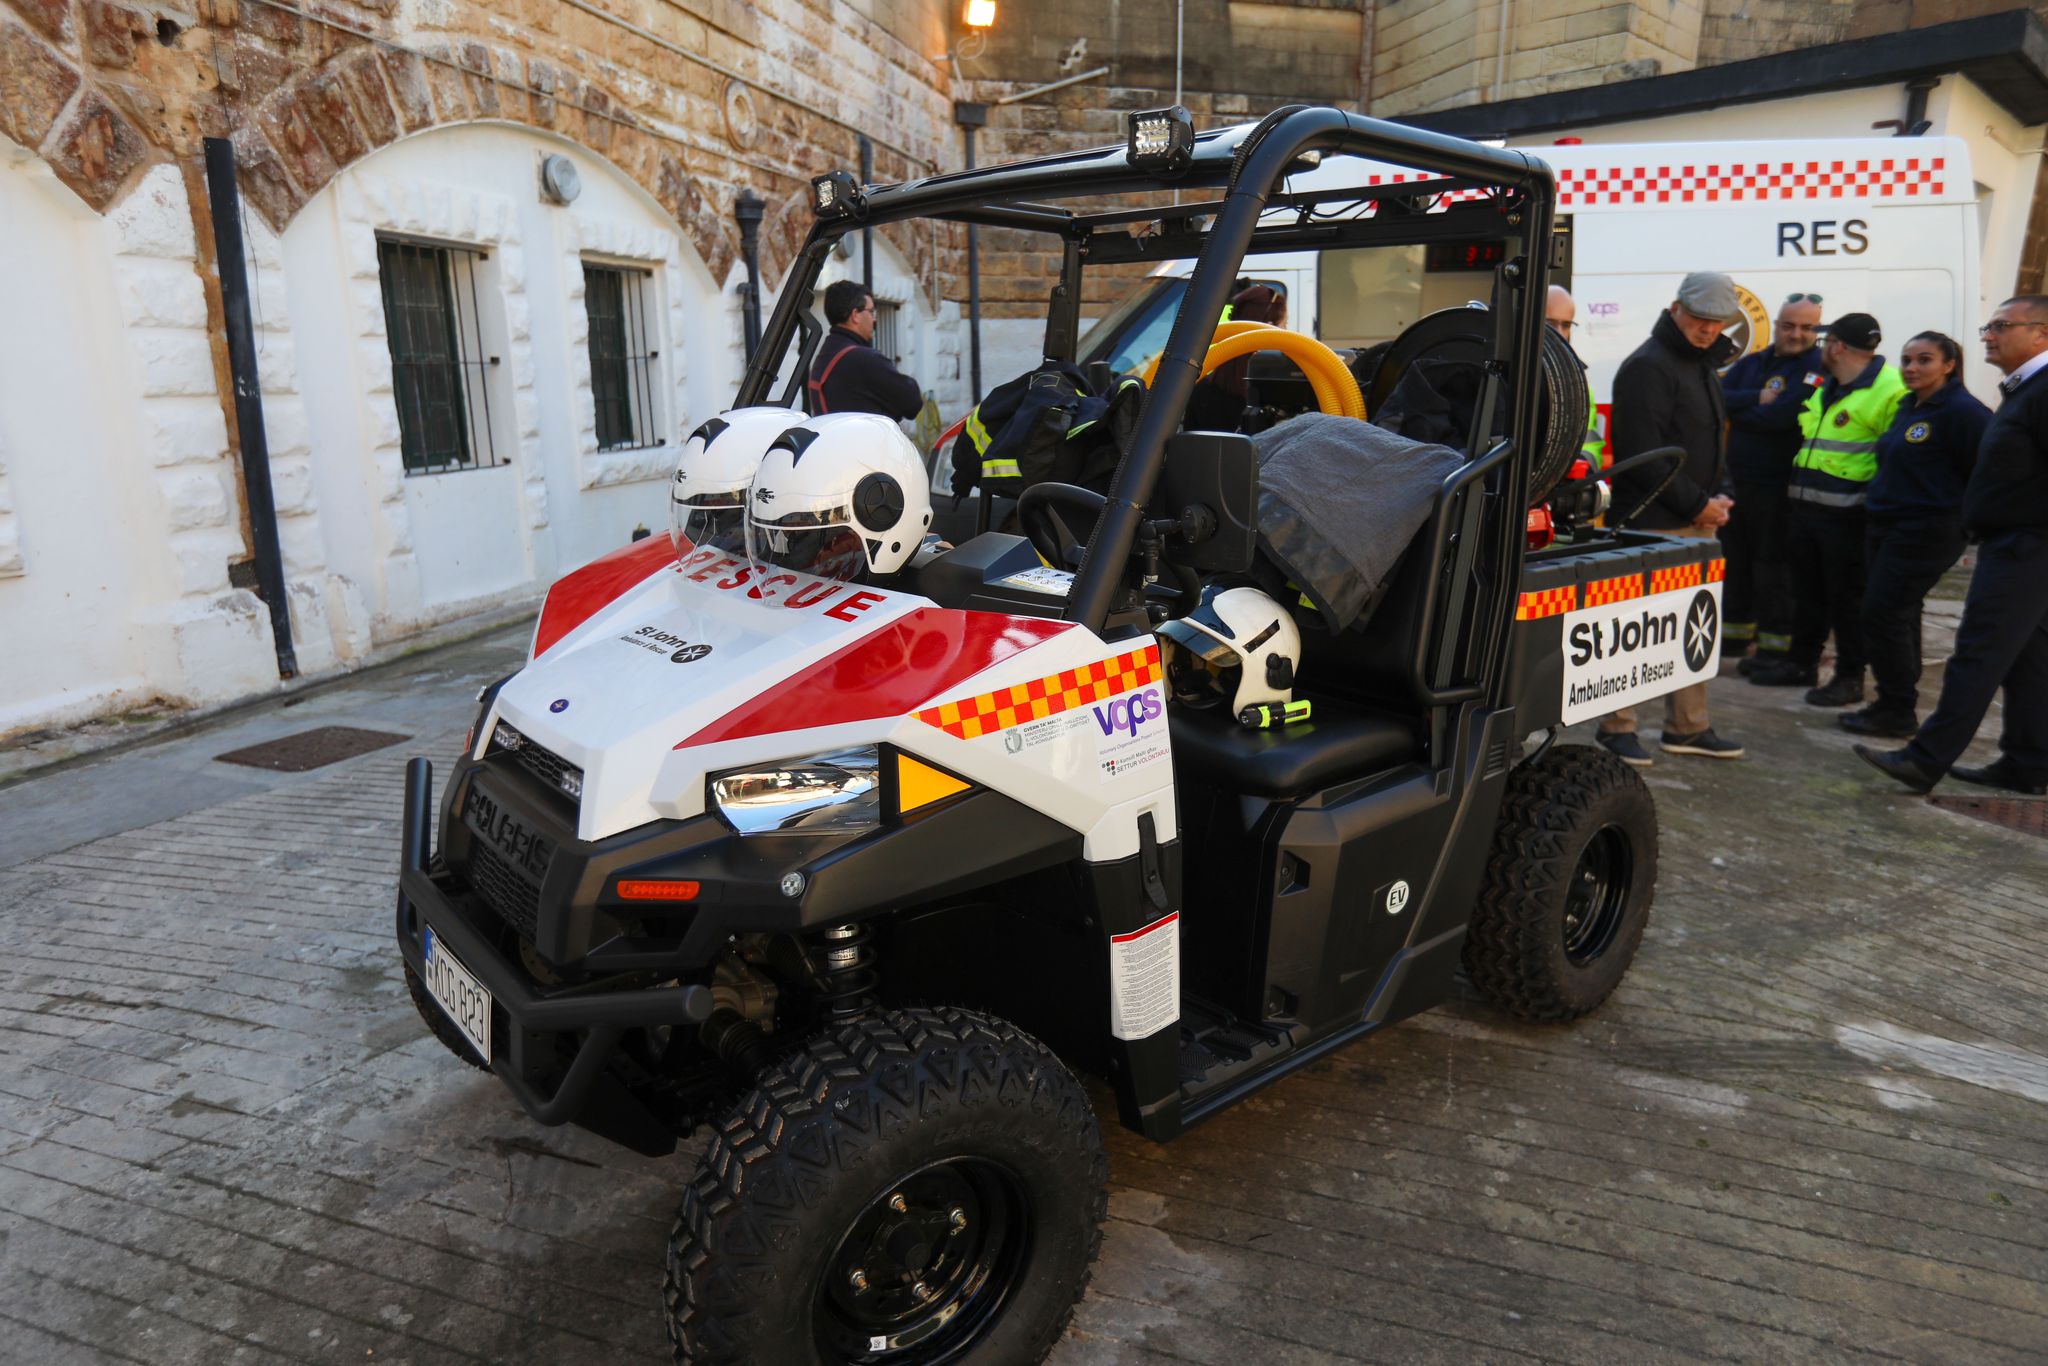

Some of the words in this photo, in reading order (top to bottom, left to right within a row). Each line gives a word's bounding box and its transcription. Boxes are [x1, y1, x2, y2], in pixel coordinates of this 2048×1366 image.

[1777, 219, 1869, 257] RES
[668, 550, 889, 623] RESCUE
[635, 626, 657, 637] St
[648, 631, 687, 649] John
[1569, 621, 1603, 667] St
[1609, 611, 1678, 657] John
[1568, 673, 1628, 707] Ambulance
[1630, 666, 1638, 688] &
[1641, 660, 1674, 684] Rescue
[1117, 761, 1138, 773] SETTUR
[1389, 887, 1407, 906] EV
[434, 949, 456, 1013] KCG
[459, 979, 484, 1045] 823
